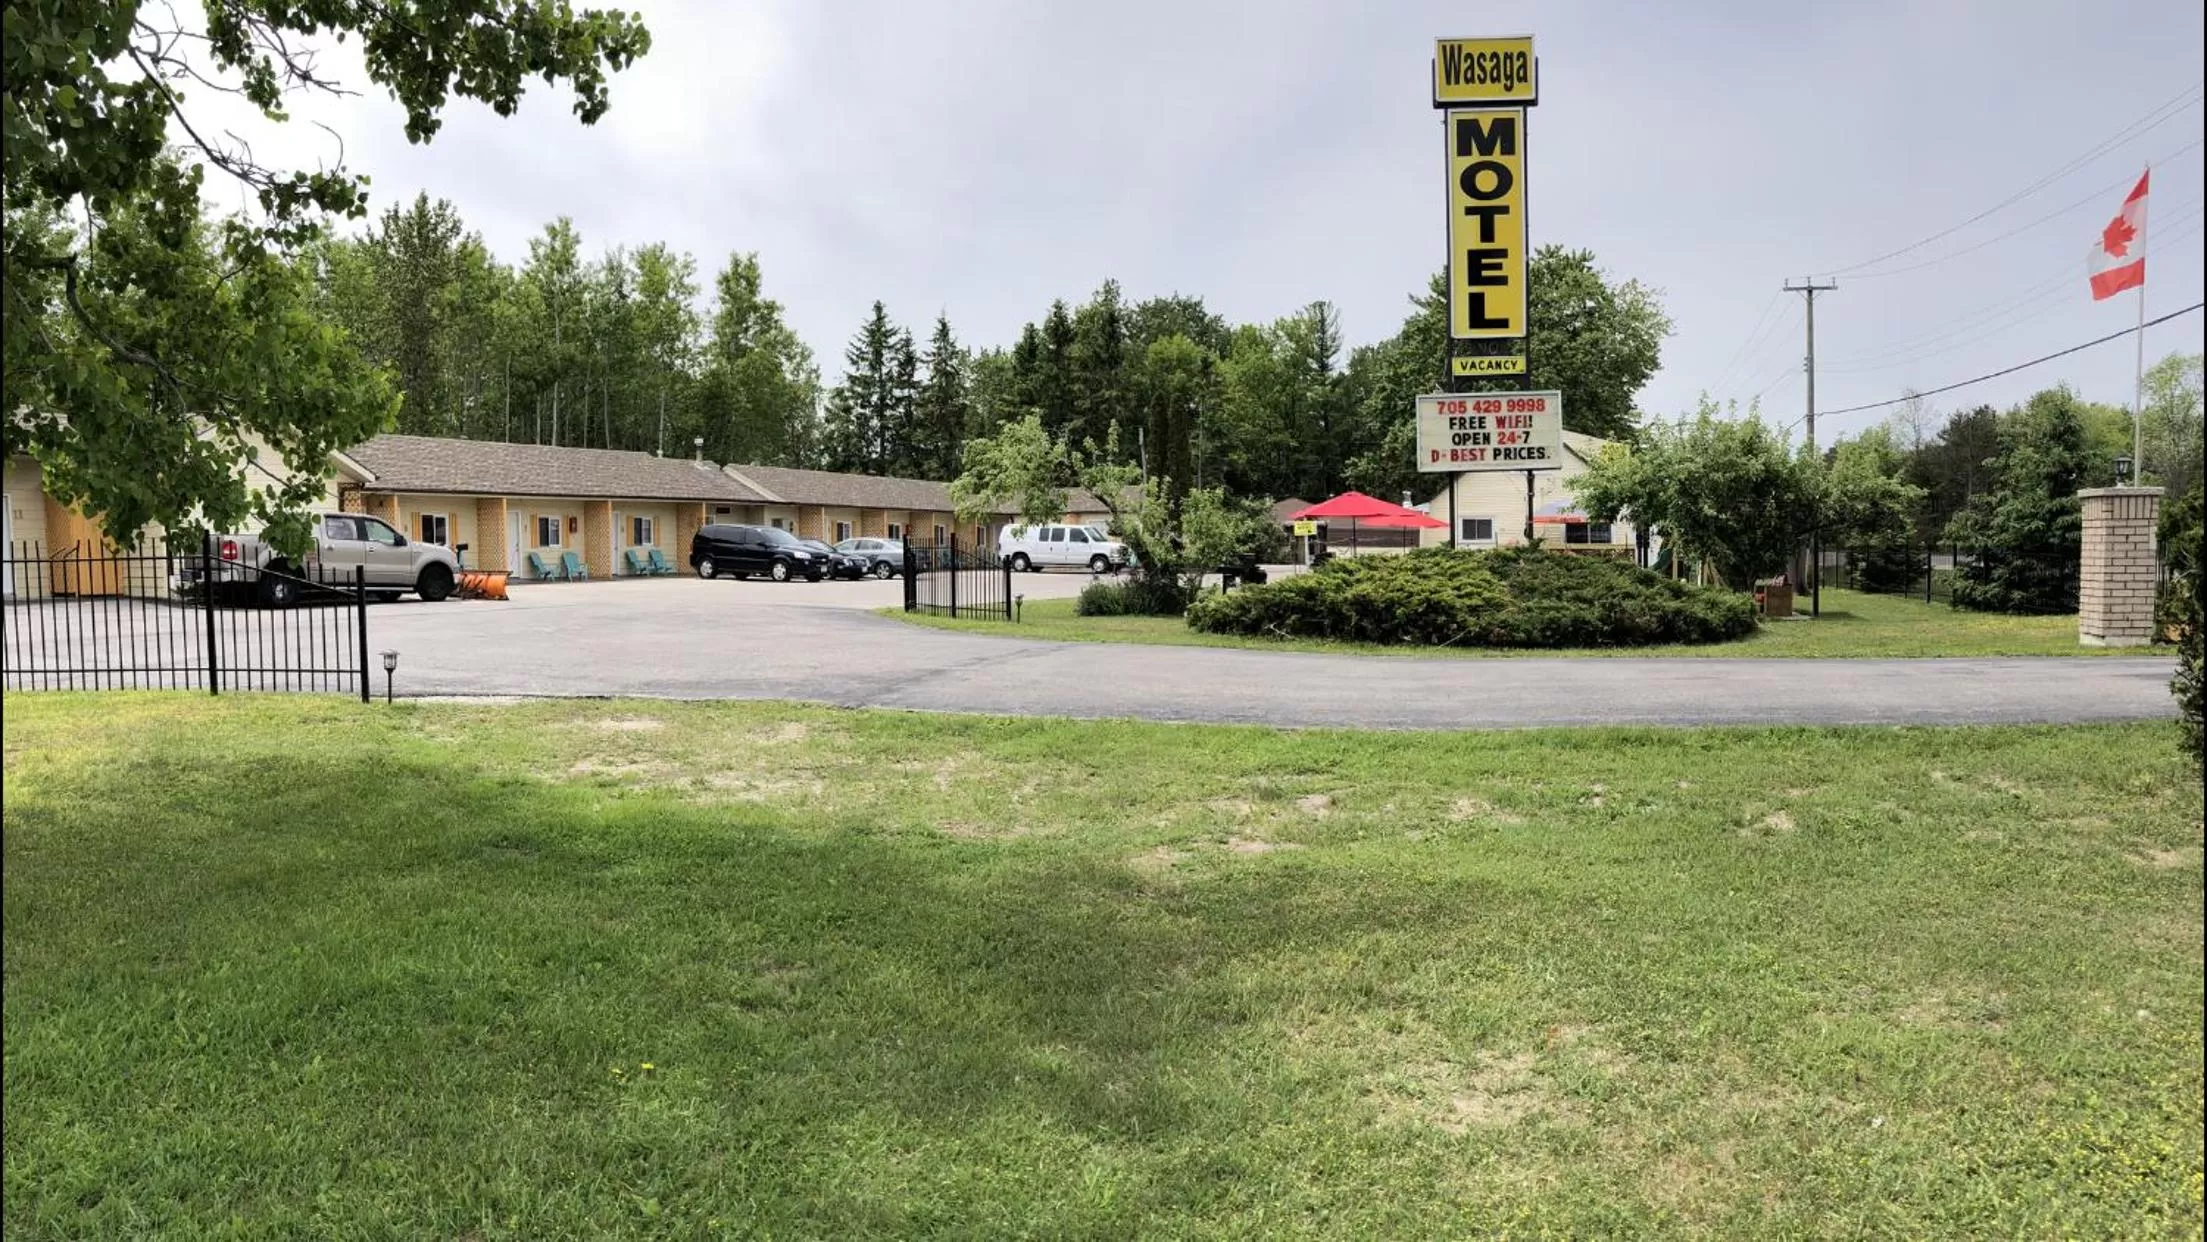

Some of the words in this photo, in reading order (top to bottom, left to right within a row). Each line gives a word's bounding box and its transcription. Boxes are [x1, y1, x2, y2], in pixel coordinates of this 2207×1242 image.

[1441, 43, 1528, 92] Wasaga
[1456, 117, 1516, 329] MOTEL
[1460, 360, 1518, 371] VACANCY
[1437, 401, 1466, 414] 705
[1472, 400, 1501, 413] 429
[1506, 399, 1546, 412] 9998
[1449, 416, 1486, 430] FREE
[1495, 415, 1533, 429] WIFI!
[1451, 432, 1490, 446] OPEN
[1497, 431, 1531, 445] 24-7
[1493, 447, 1551, 460] PRICES.
